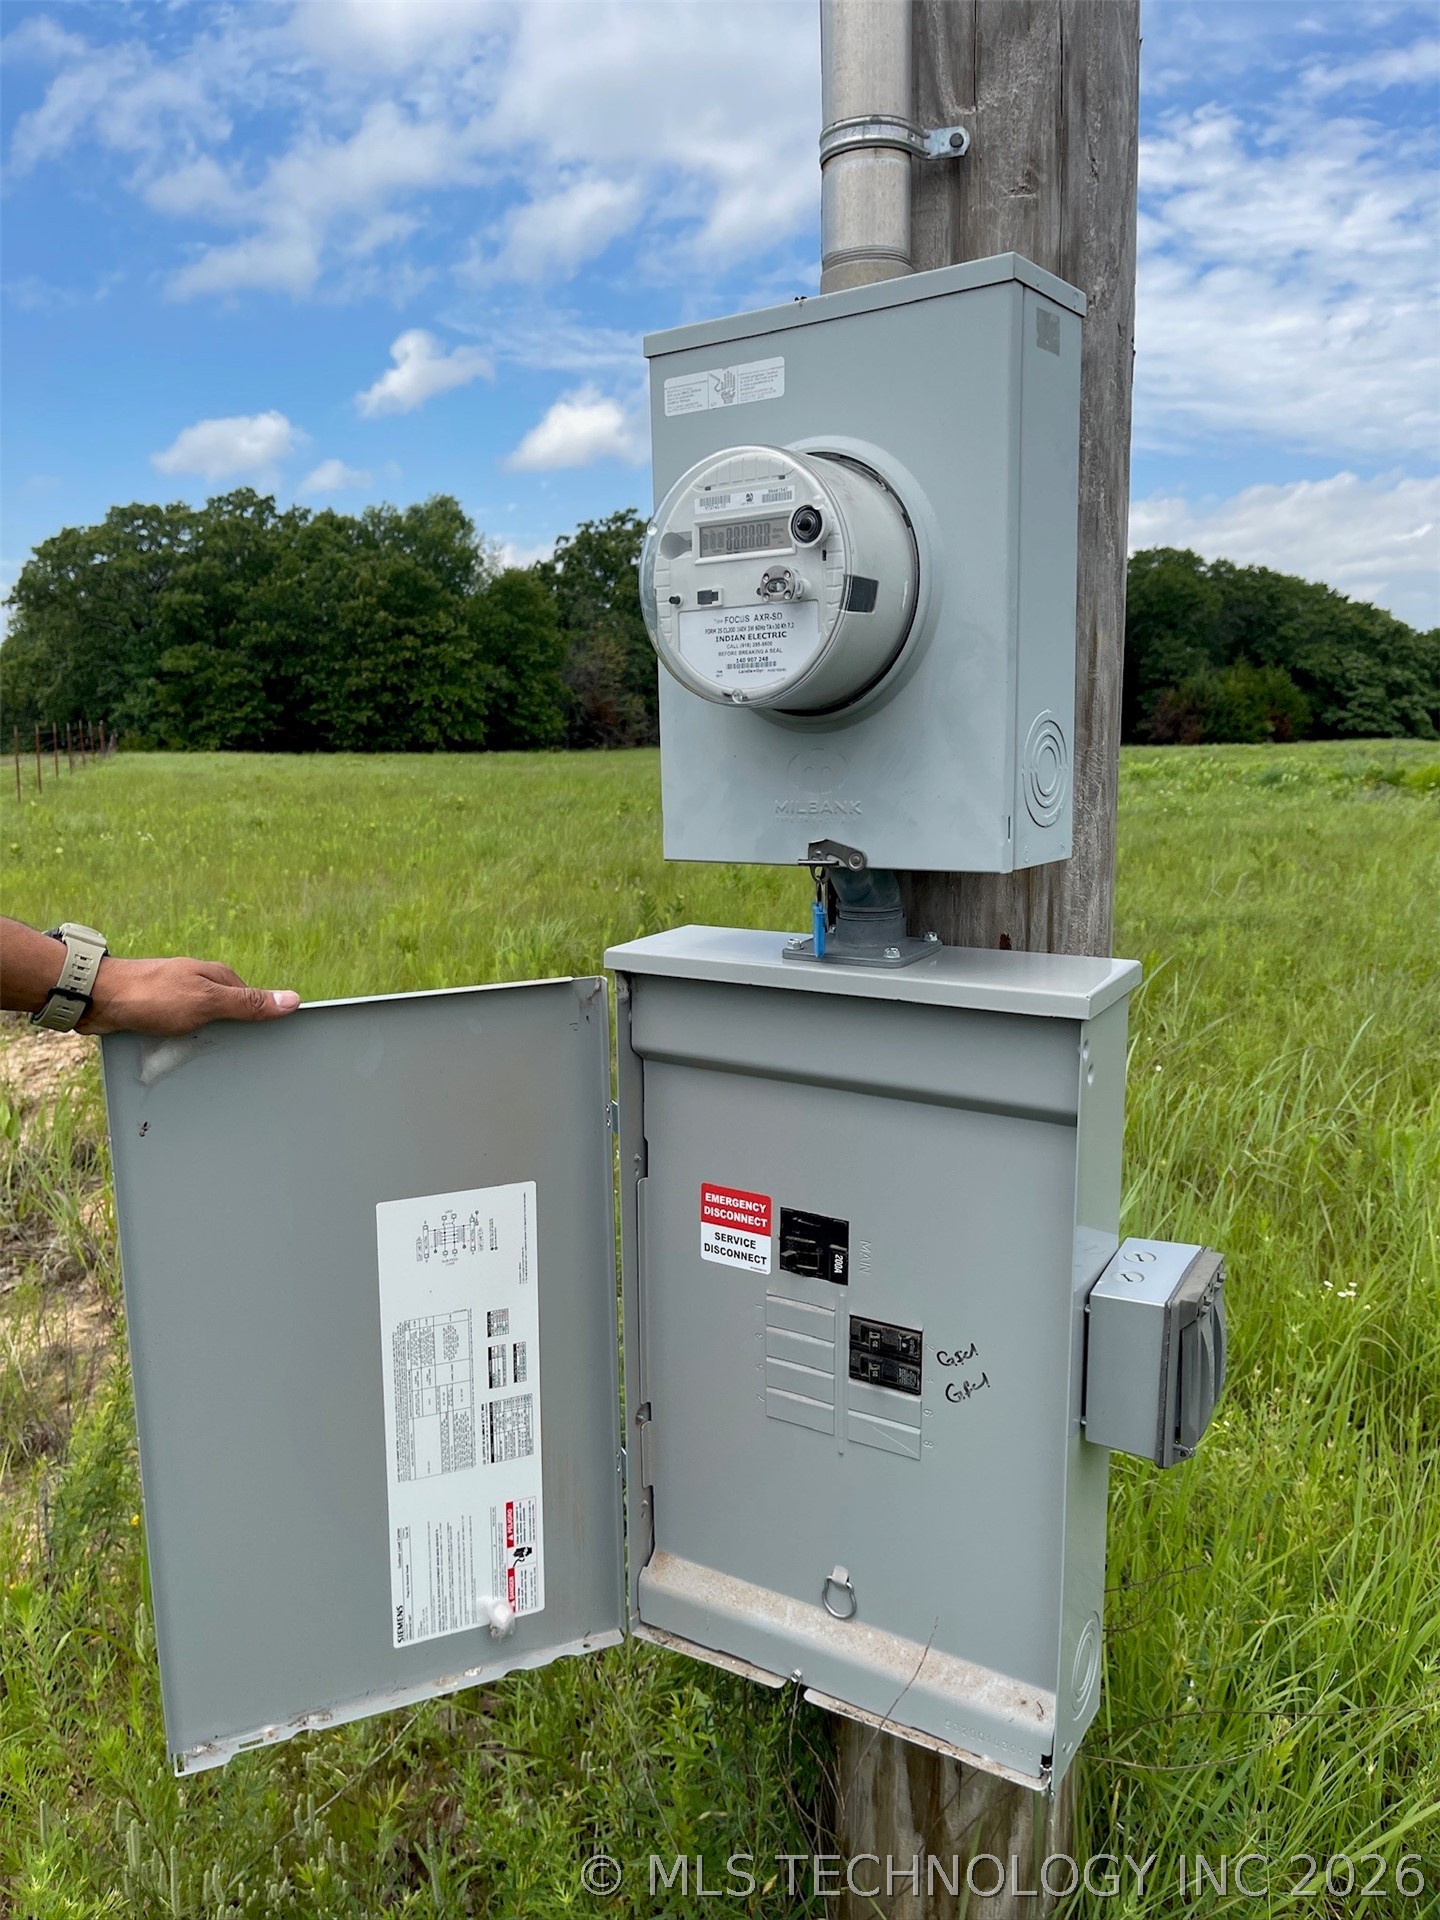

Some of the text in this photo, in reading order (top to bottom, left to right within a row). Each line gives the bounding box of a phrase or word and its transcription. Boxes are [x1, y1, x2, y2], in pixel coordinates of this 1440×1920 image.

[724, 614, 750, 624] FOCUS
[754, 612, 783, 622] AXR-SD
[715, 631, 788, 643] INDIAN ELECTRIC
[775, 799, 862, 816] MILBANK
[705, 1192, 767, 1214] EMERGENCY
[704, 1205, 768, 1228] DISCONNECT
[714, 1231, 757, 1250] SERVICE
[704, 1242, 768, 1266] DISCONNECT
[859, 1239, 872, 1276] MAIN
[396, 1605, 404, 1643] SIEMENS
